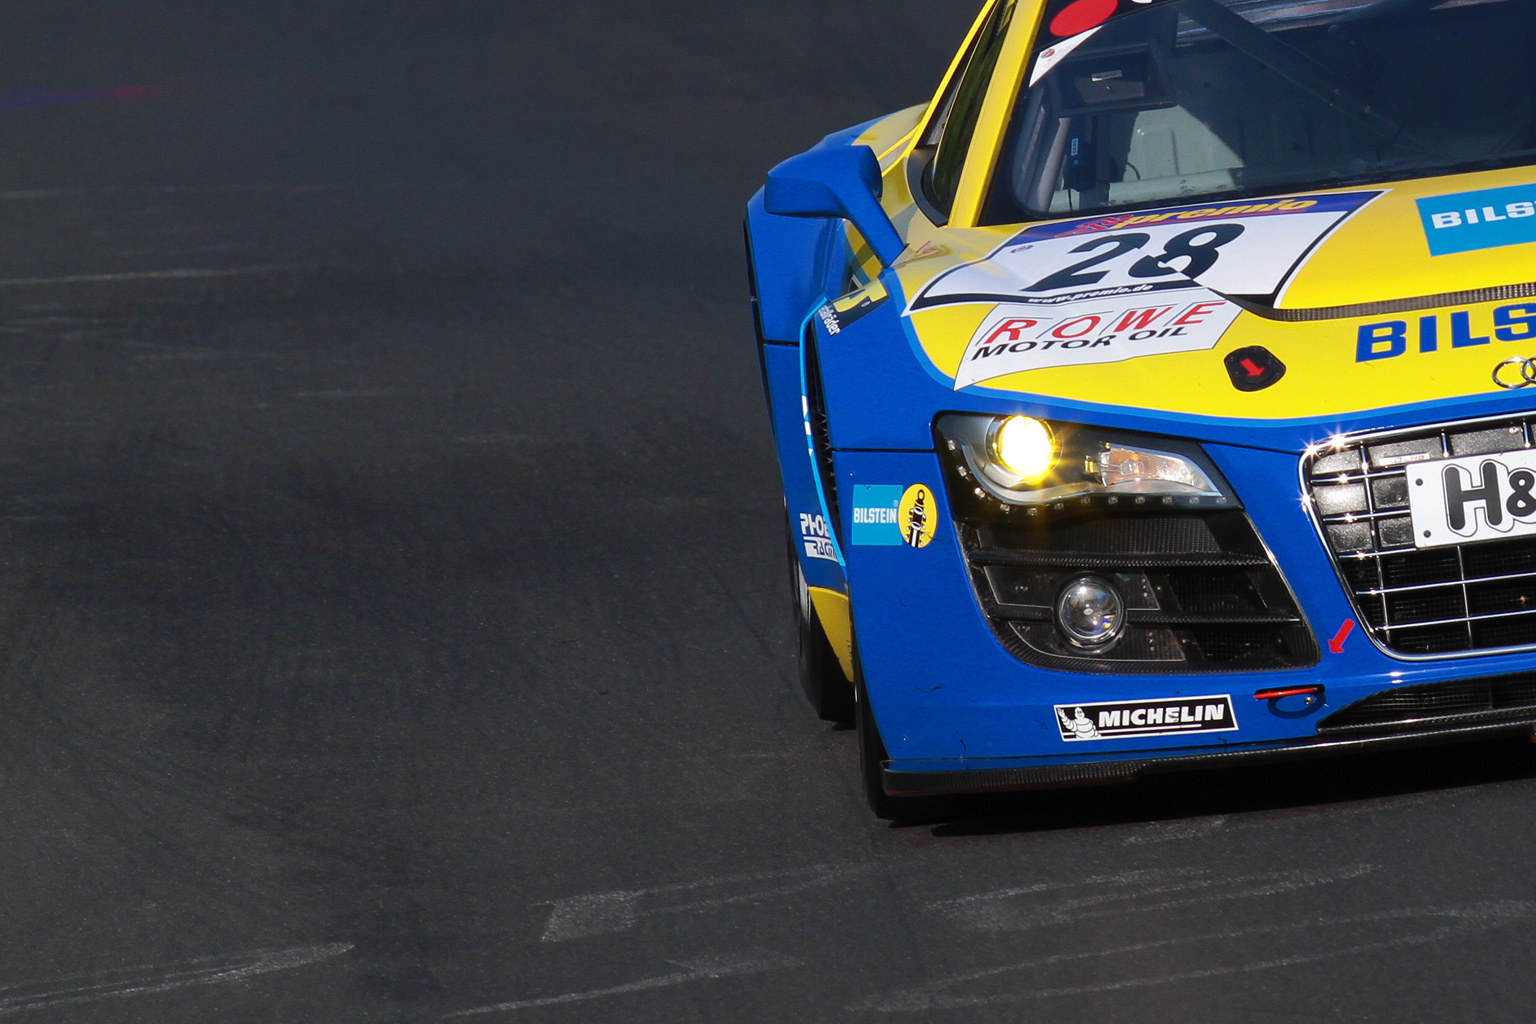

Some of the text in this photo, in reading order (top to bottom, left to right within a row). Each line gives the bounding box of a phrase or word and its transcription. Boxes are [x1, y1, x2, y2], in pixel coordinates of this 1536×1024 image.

[1108, 198, 1318, 230] premio
[1018, 223, 1245, 292] 28
[1028, 283, 1153, 304] www.premio.de
[984, 302, 1227, 344] ROWE
[971, 326, 1189, 361] MOTOR OIL
[853, 506, 898, 524] BILSTEIN
[1098, 703, 1224, 728] MICHELIN
